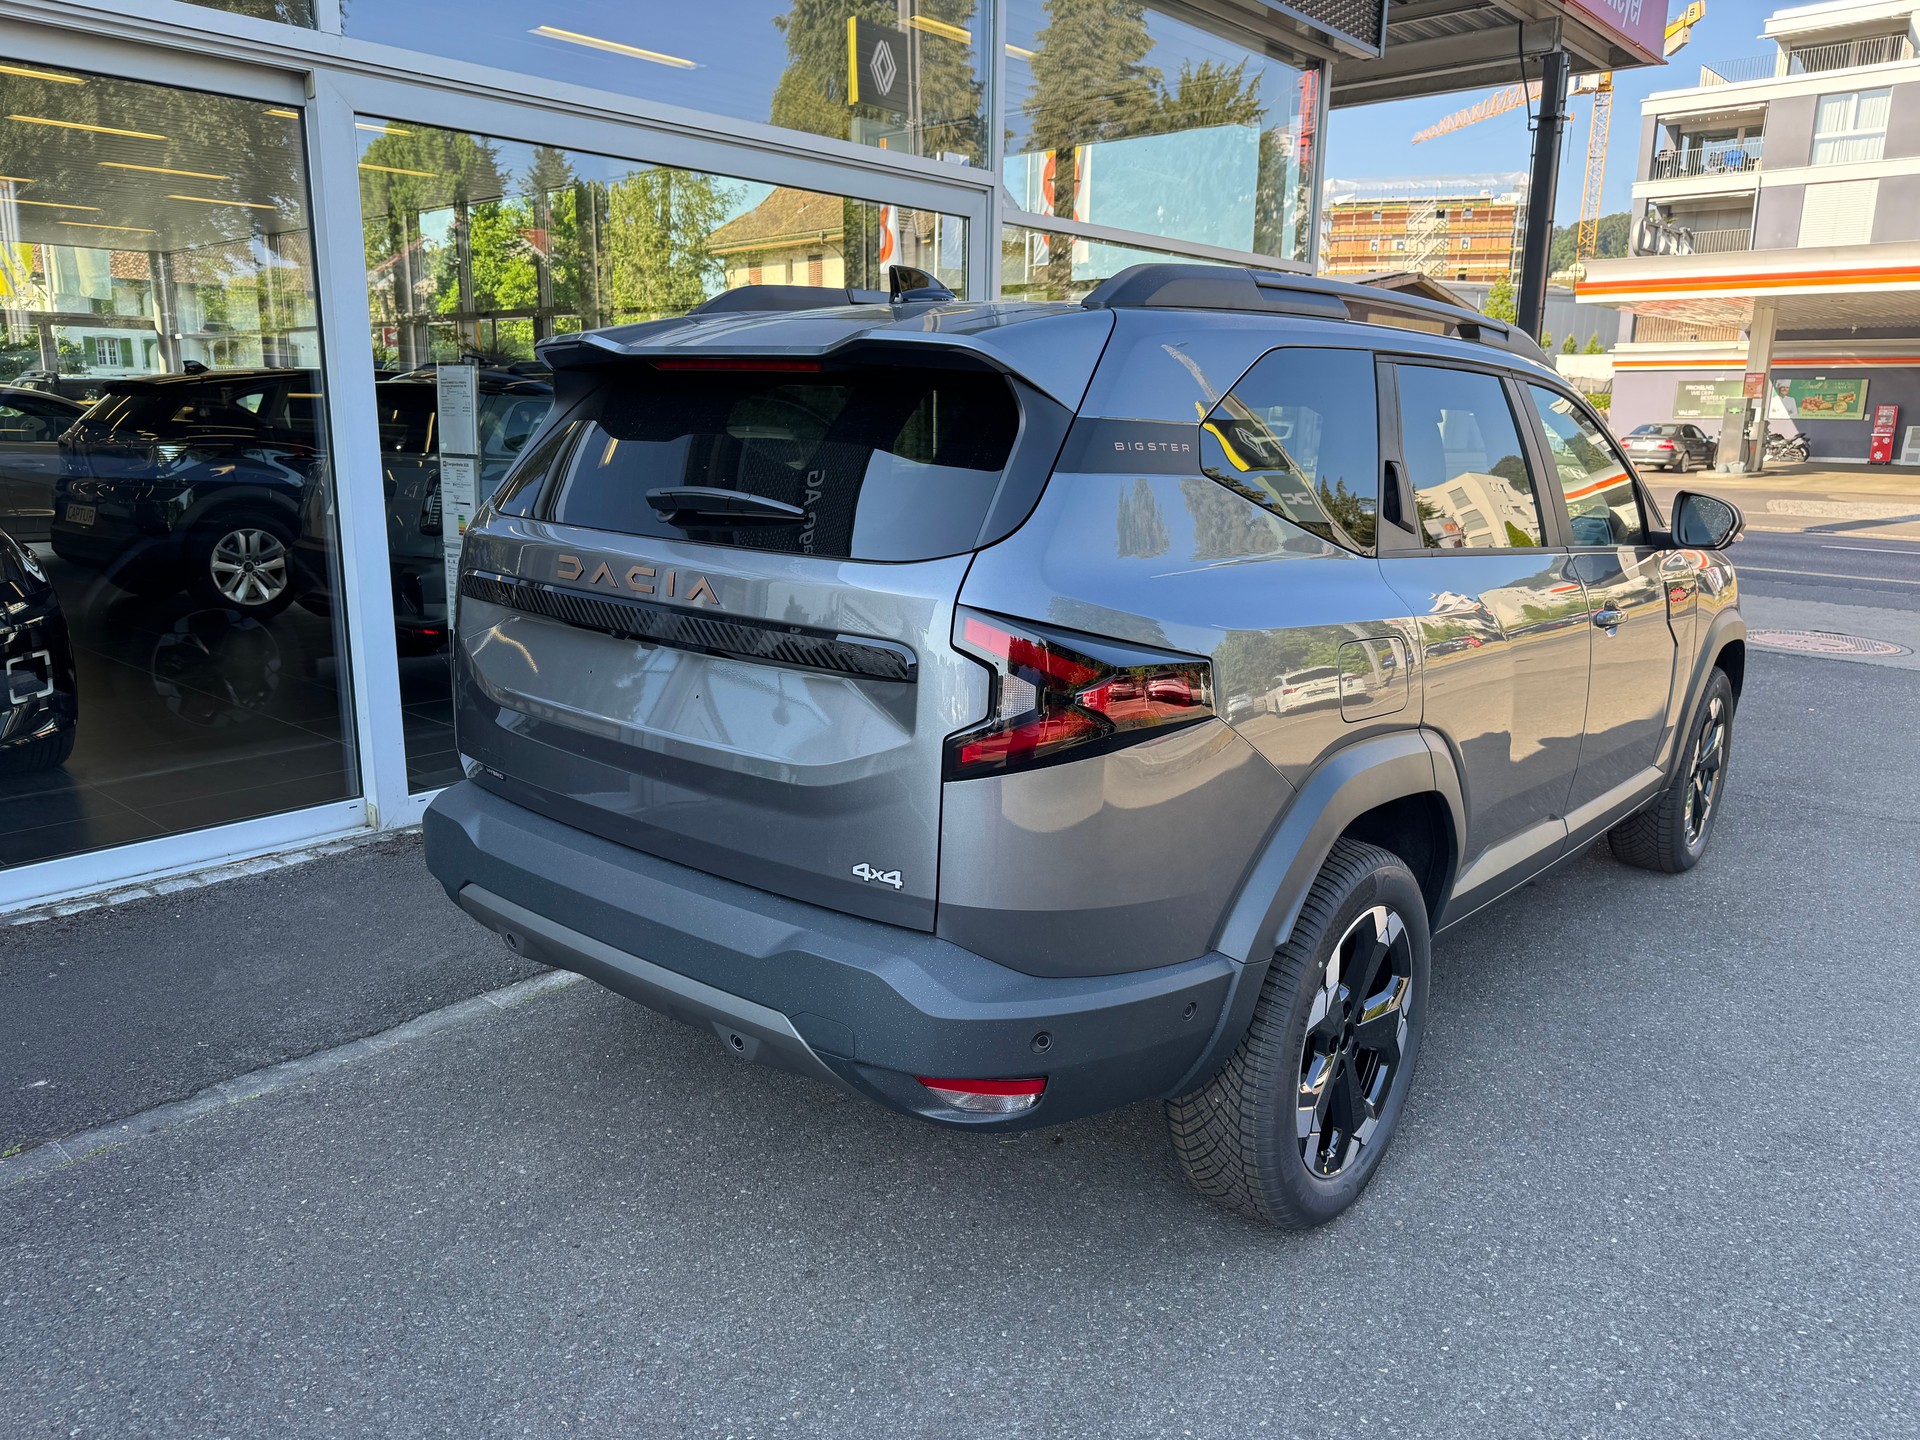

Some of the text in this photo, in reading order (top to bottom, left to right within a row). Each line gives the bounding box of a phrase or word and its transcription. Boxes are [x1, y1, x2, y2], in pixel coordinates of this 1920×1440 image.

[1114, 442, 1190, 452] BIGSTER
[68, 505, 94, 523] CAPTUR
[556, 554, 720, 605] DACIA
[852, 862, 904, 890] 4x4
